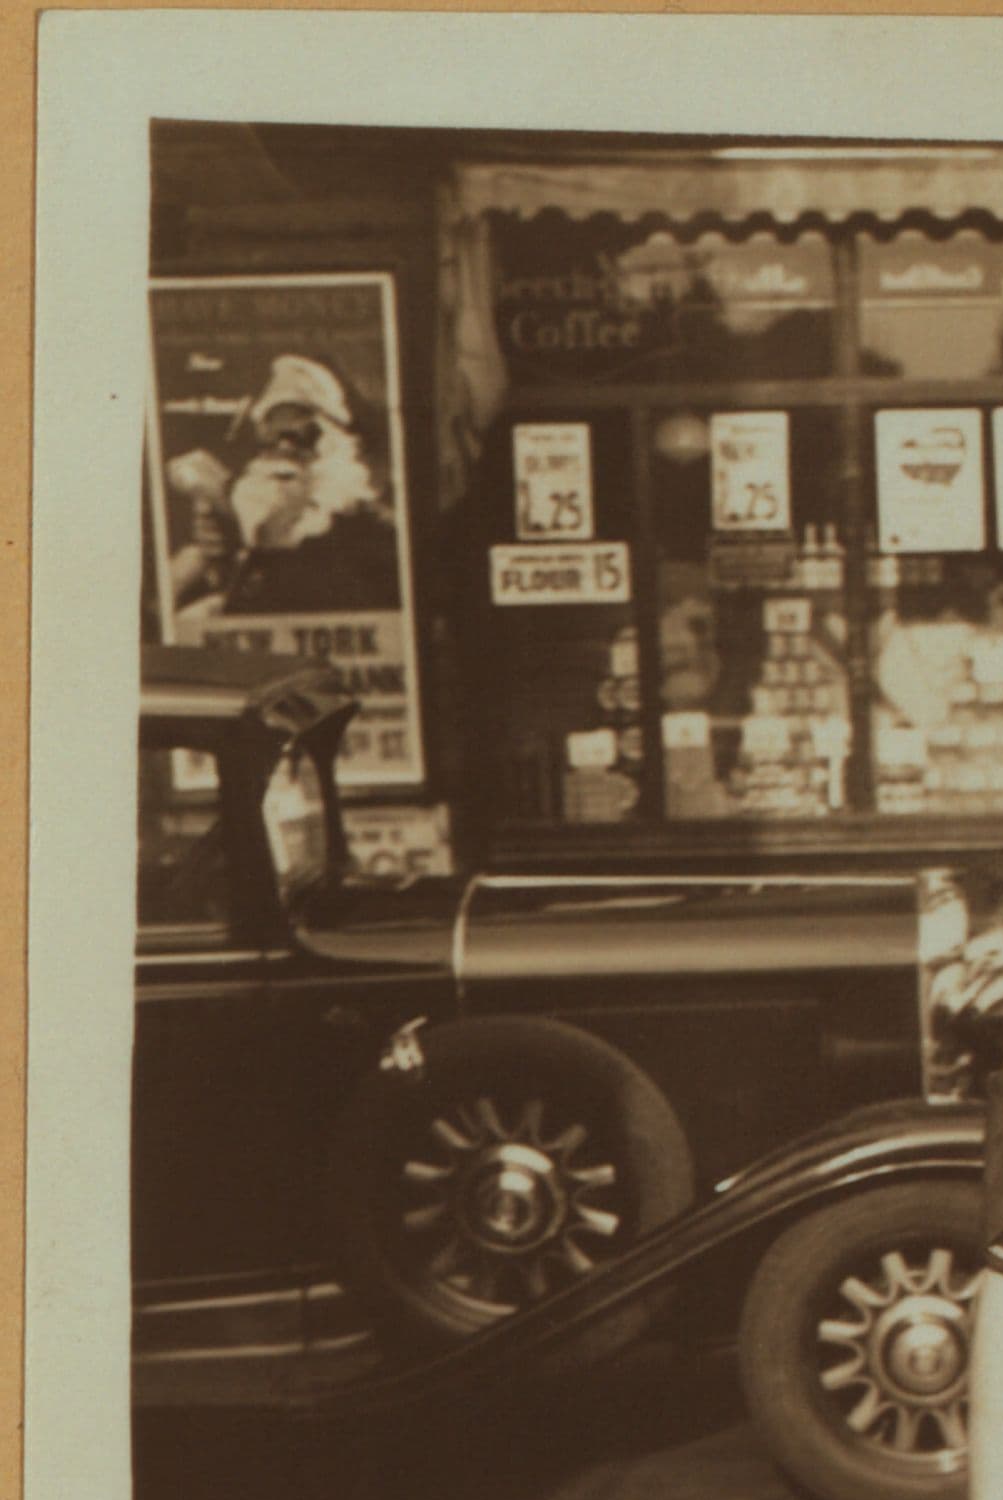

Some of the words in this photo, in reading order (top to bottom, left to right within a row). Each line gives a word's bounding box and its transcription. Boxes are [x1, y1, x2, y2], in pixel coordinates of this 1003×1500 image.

[509, 309, 641, 350] Coffee
[500, 568, 582, 593] FLOUR
[593, 551, 622, 592] 15
[293, 625, 379, 657] YORK
